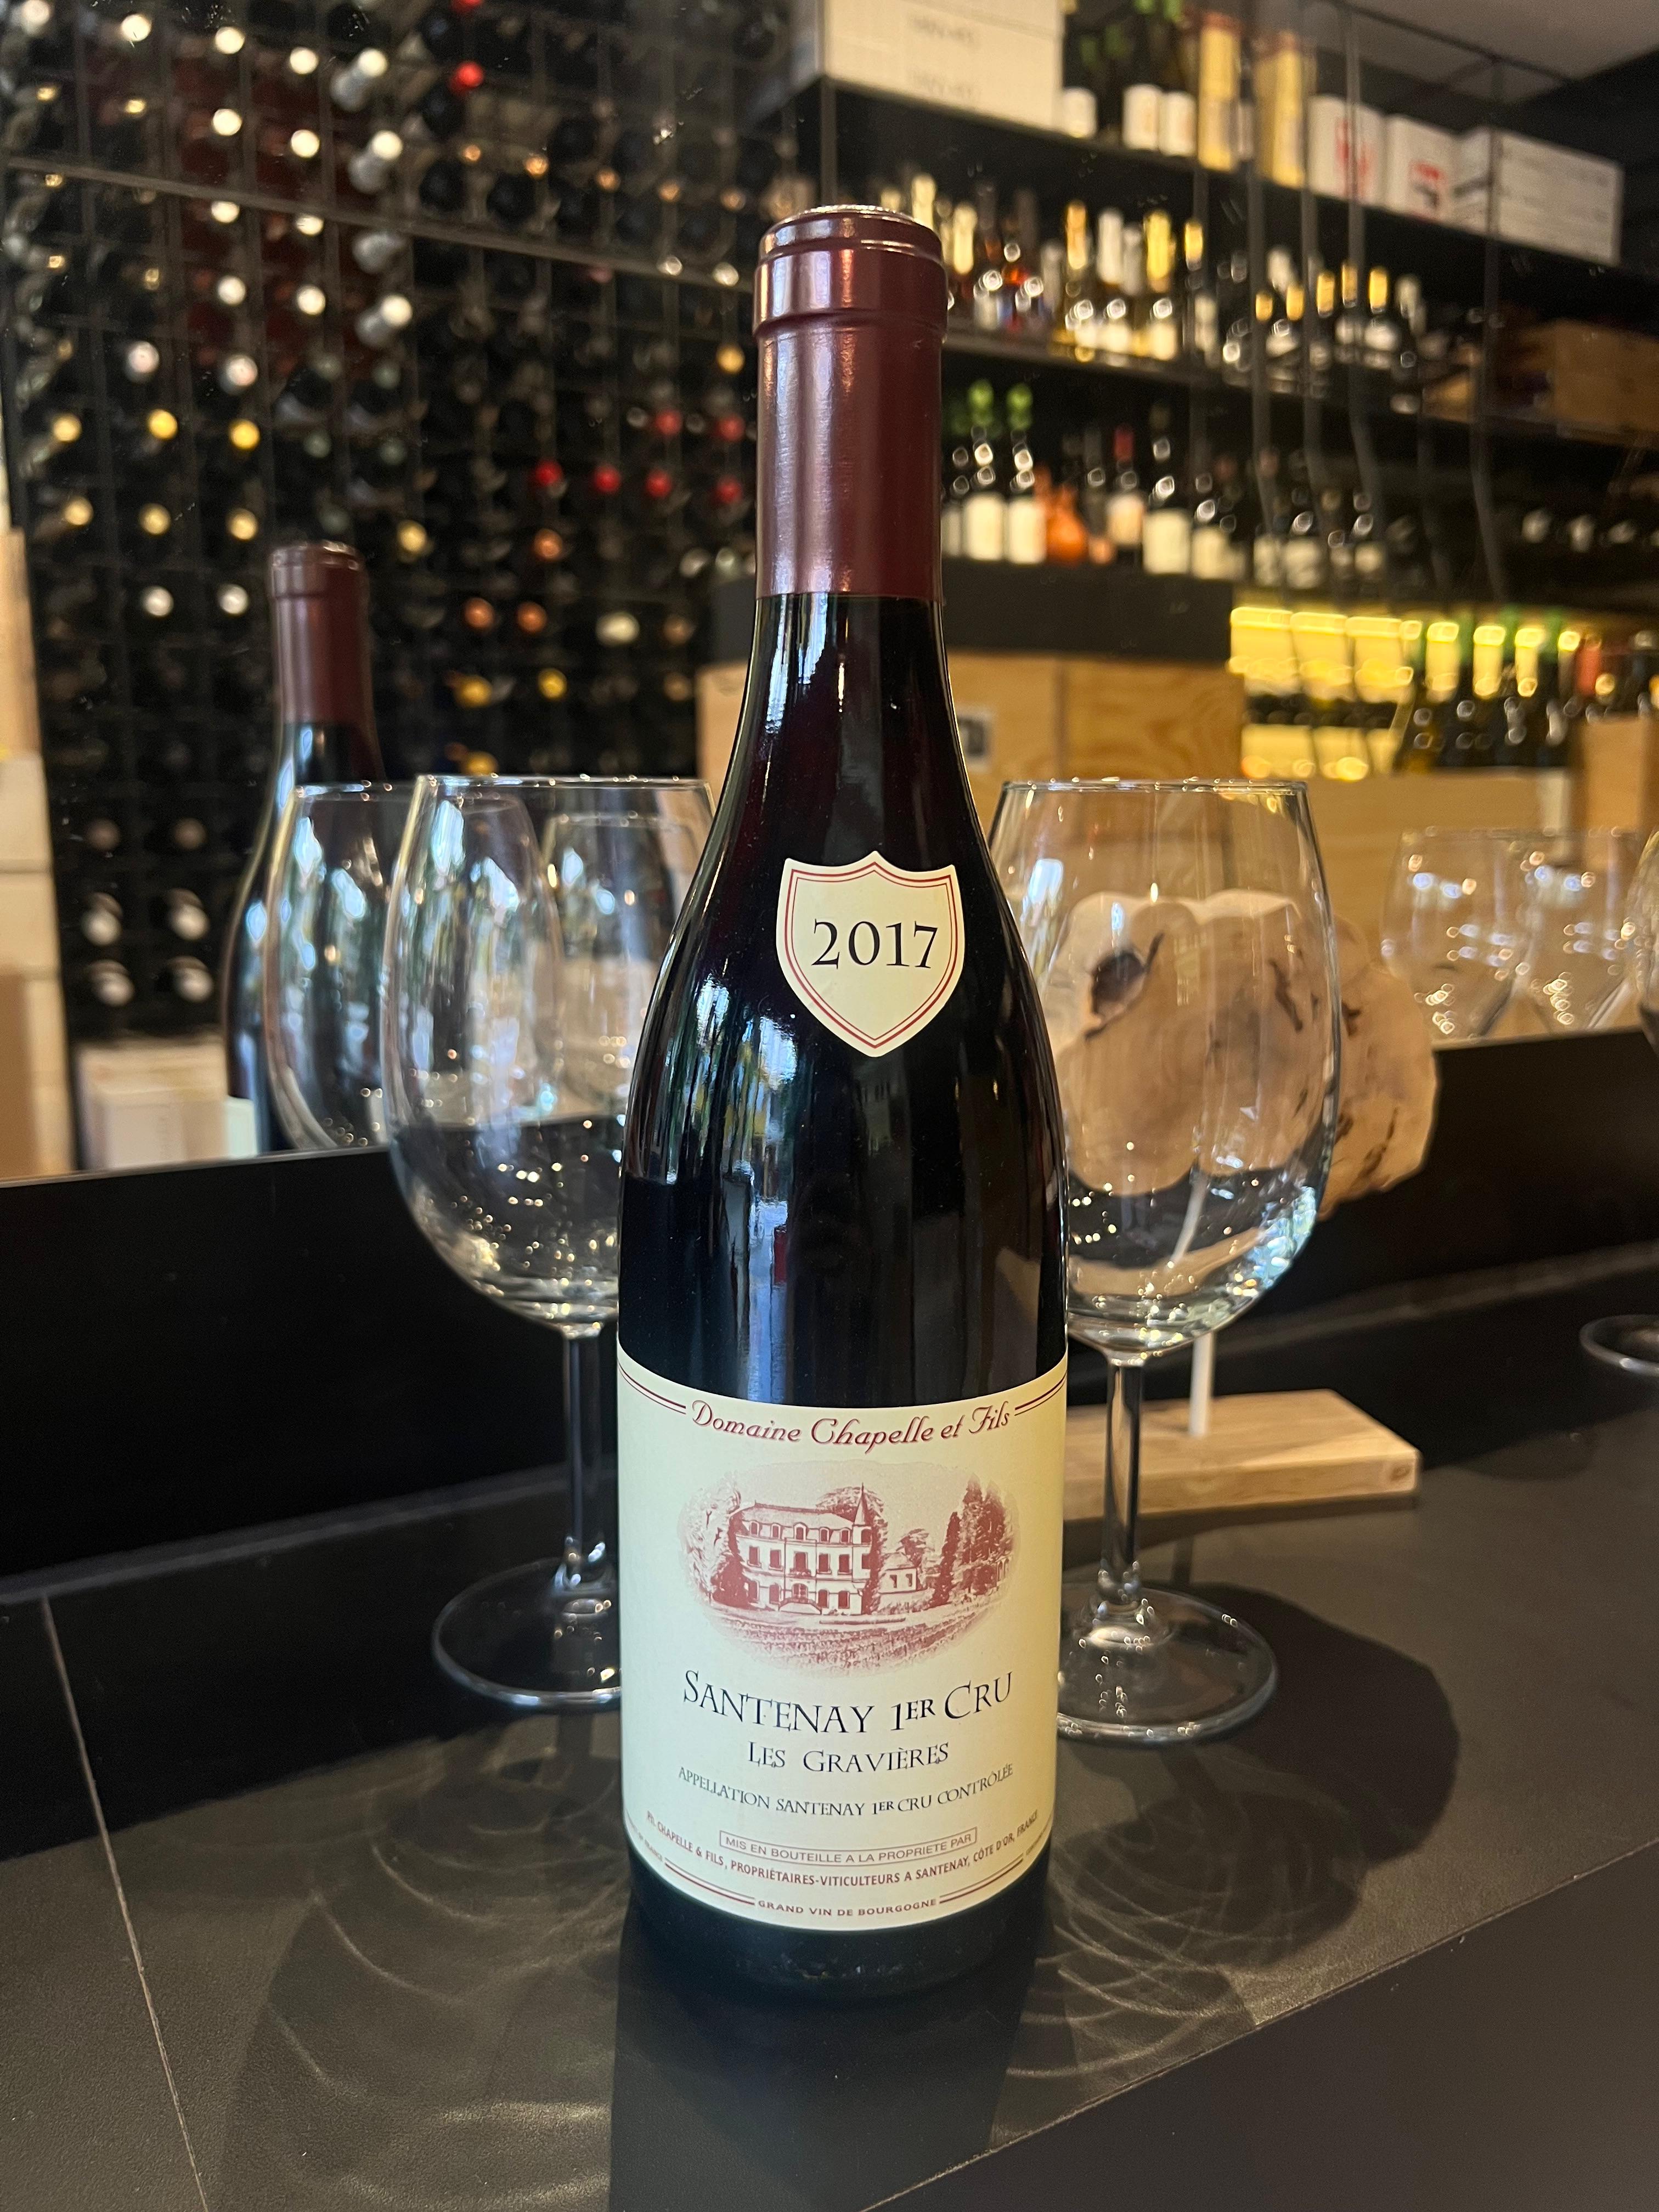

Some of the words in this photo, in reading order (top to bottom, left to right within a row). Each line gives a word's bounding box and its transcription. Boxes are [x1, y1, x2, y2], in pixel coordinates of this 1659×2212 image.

[811, 918, 938, 969] 2017
[691, 1400, 802, 1444] Domaine
[811, 1416, 934, 1455] Chapelle
[940, 1415, 962, 1438] et
[968, 1400, 1010, 1435] Fils
[684, 1669, 875, 1734] SANTENAY
[890, 1699, 936, 1731] 1ER
[944, 1671, 1013, 1719] CRU
[748, 1740, 786, 1768] LES
[803, 1741, 949, 1773] GRAVIÈRES
[678, 1766, 770, 1809] APPELLATION
[776, 1797, 865, 1816] SANTENAY
[872, 1800, 895, 1815] 1ER
[898, 1794, 932, 1812] CRU
[937, 1763, 1014, 1804] CONTRÔLÉE
[657, 1821, 693, 1853] CHAPELLE
[696, 1847, 703, 1858] &
[731, 1859, 900, 1887] PROPRIÉTAIRES-VITICULTEURS
[904, 1871, 912, 1882] A
[916, 1855, 970, 1880] SANTENAY,
[973, 1844, 994, 1863] CÔTE
[726, 1836, 747, 1850] MIS
[751, 1843, 767, 1855] EN
[771, 1848, 842, 1863] BOUTEILLE
[845, 1854, 855, 1863] A
[859, 1854, 875, 1863] LA
[878, 1842, 947, 1861] PROPRIETE
[950, 1833, 972, 1848] PAR
[758, 1900, 804, 1914] GRAND
[809, 1907, 832, 1916] VIN
[858, 1898, 936, 1916] BOURGOGNE
